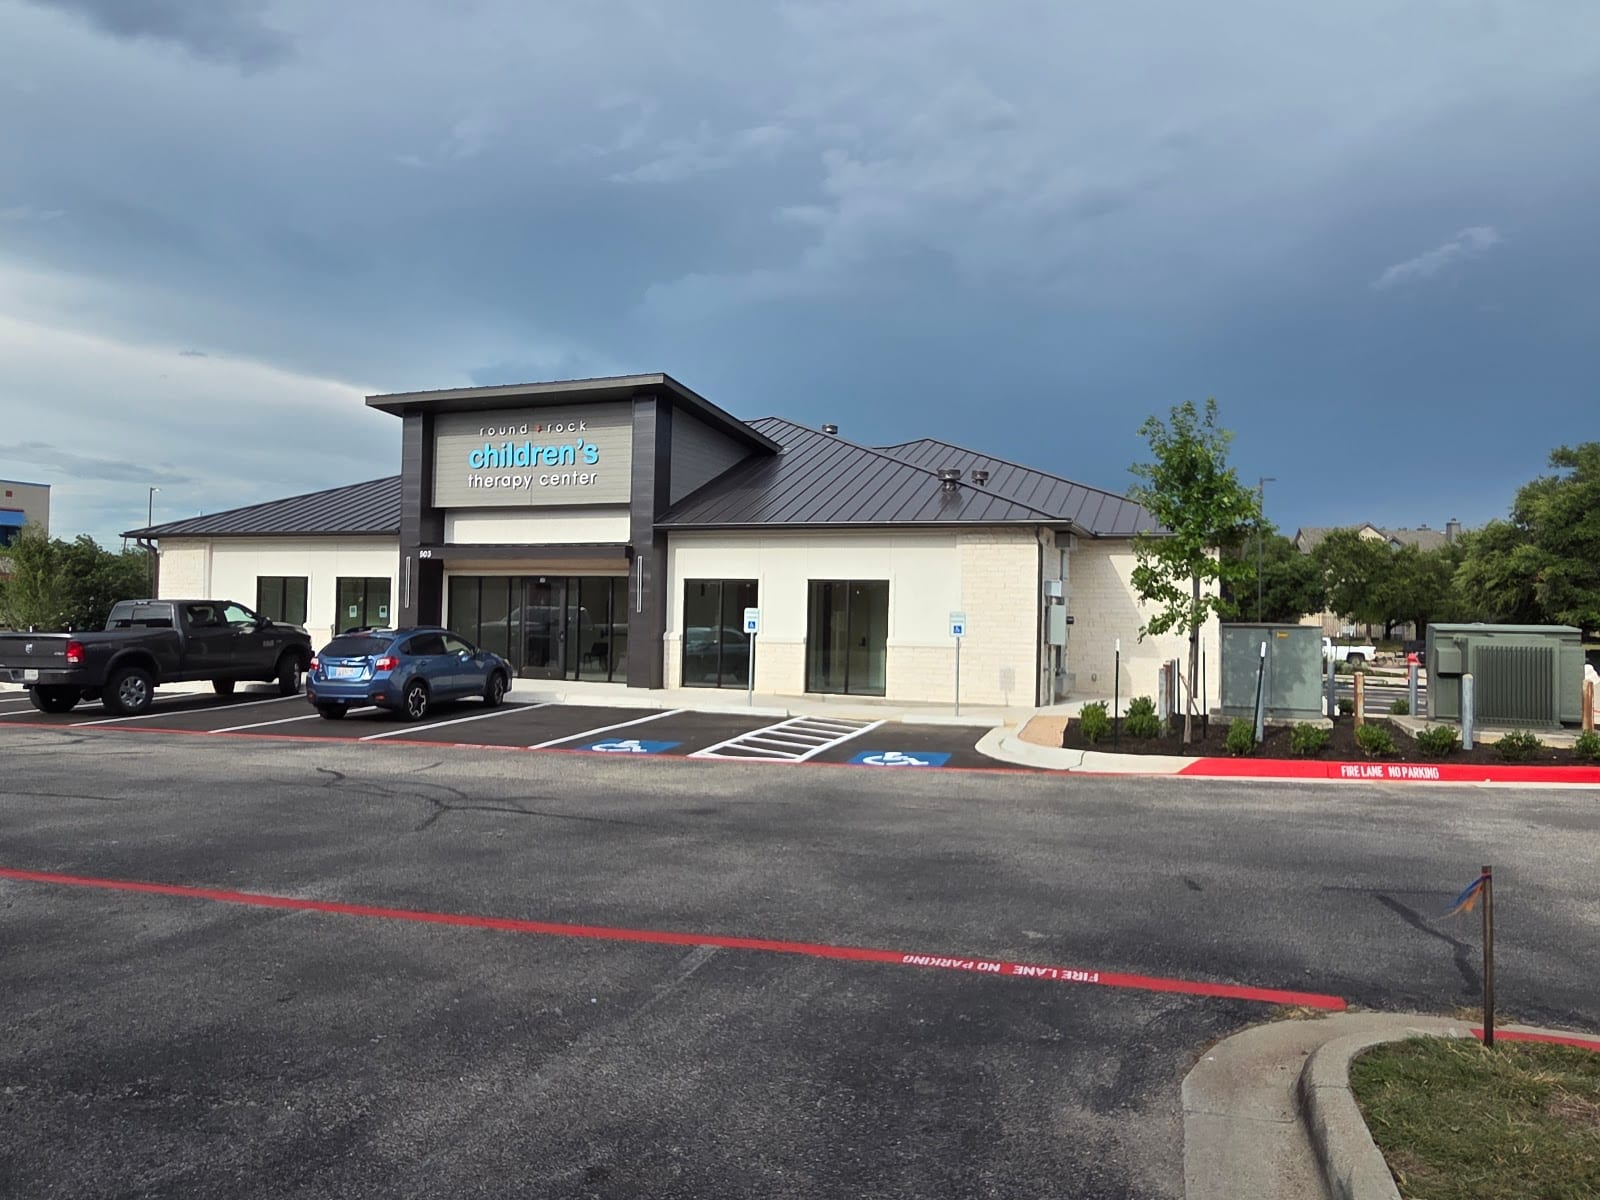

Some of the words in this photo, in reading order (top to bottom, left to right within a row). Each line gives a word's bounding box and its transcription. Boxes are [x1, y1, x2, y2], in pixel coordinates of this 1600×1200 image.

[480, 423, 528, 436] round
[547, 420, 587, 433] rock
[468, 438, 599, 469] children's
[468, 474, 533, 490] therapy
[539, 470, 597, 486] center
[1341, 765, 1360, 777] FIRE
[1361, 765, 1384, 777] LANE
[1388, 766, 1401, 778] NO
[1402, 767, 1440, 779] PARKING
[902, 955, 974, 969] PARKING
[977, 962, 1001, 972] NO
[1012, 965, 1058, 978] LANE
[1061, 970, 1099, 983] FIRE
